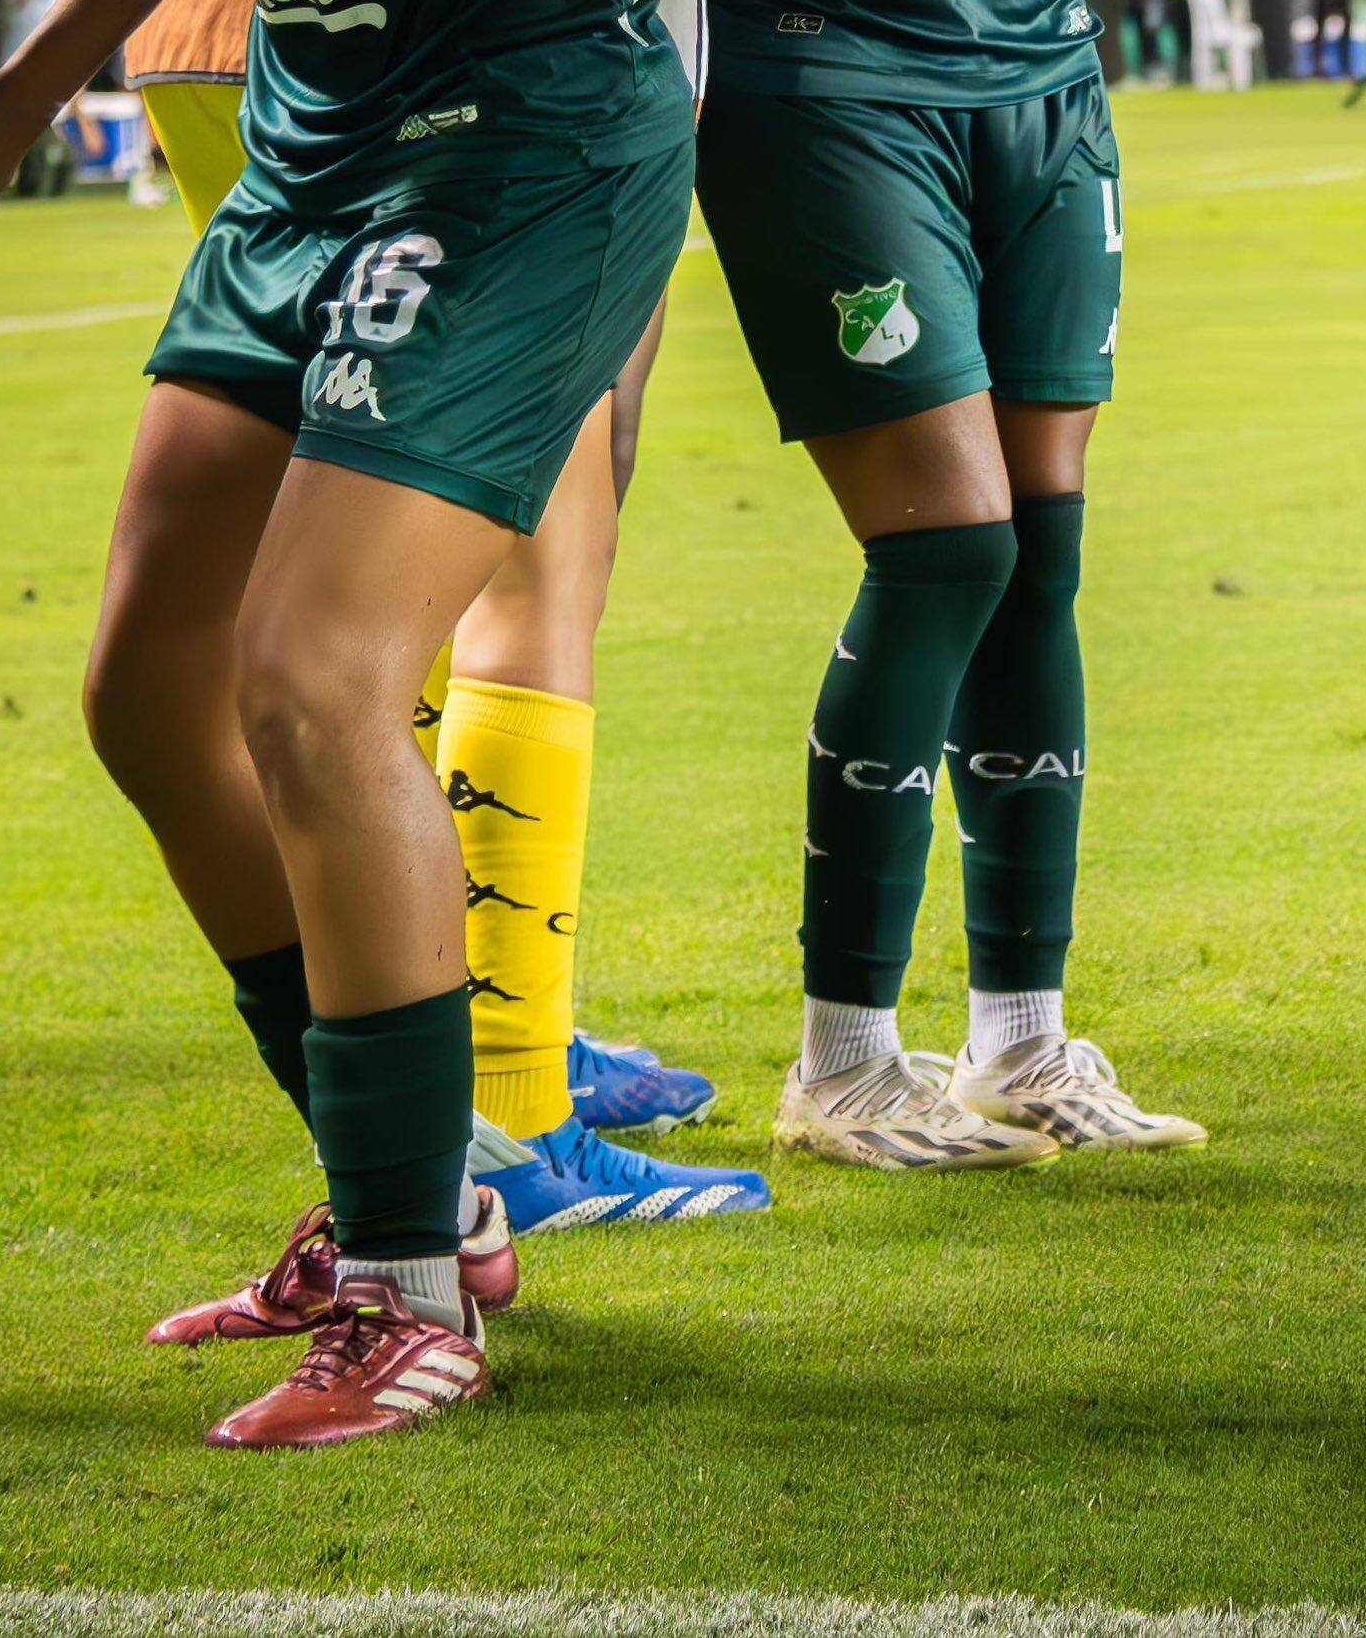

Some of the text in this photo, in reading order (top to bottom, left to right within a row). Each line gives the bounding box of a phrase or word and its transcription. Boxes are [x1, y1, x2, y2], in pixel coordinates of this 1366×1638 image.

[323, 234, 444, 346] 16
[845, 308, 906, 348] CALI
[842, 760, 938, 796] CA
[970, 748, 1085, 780] CAL
